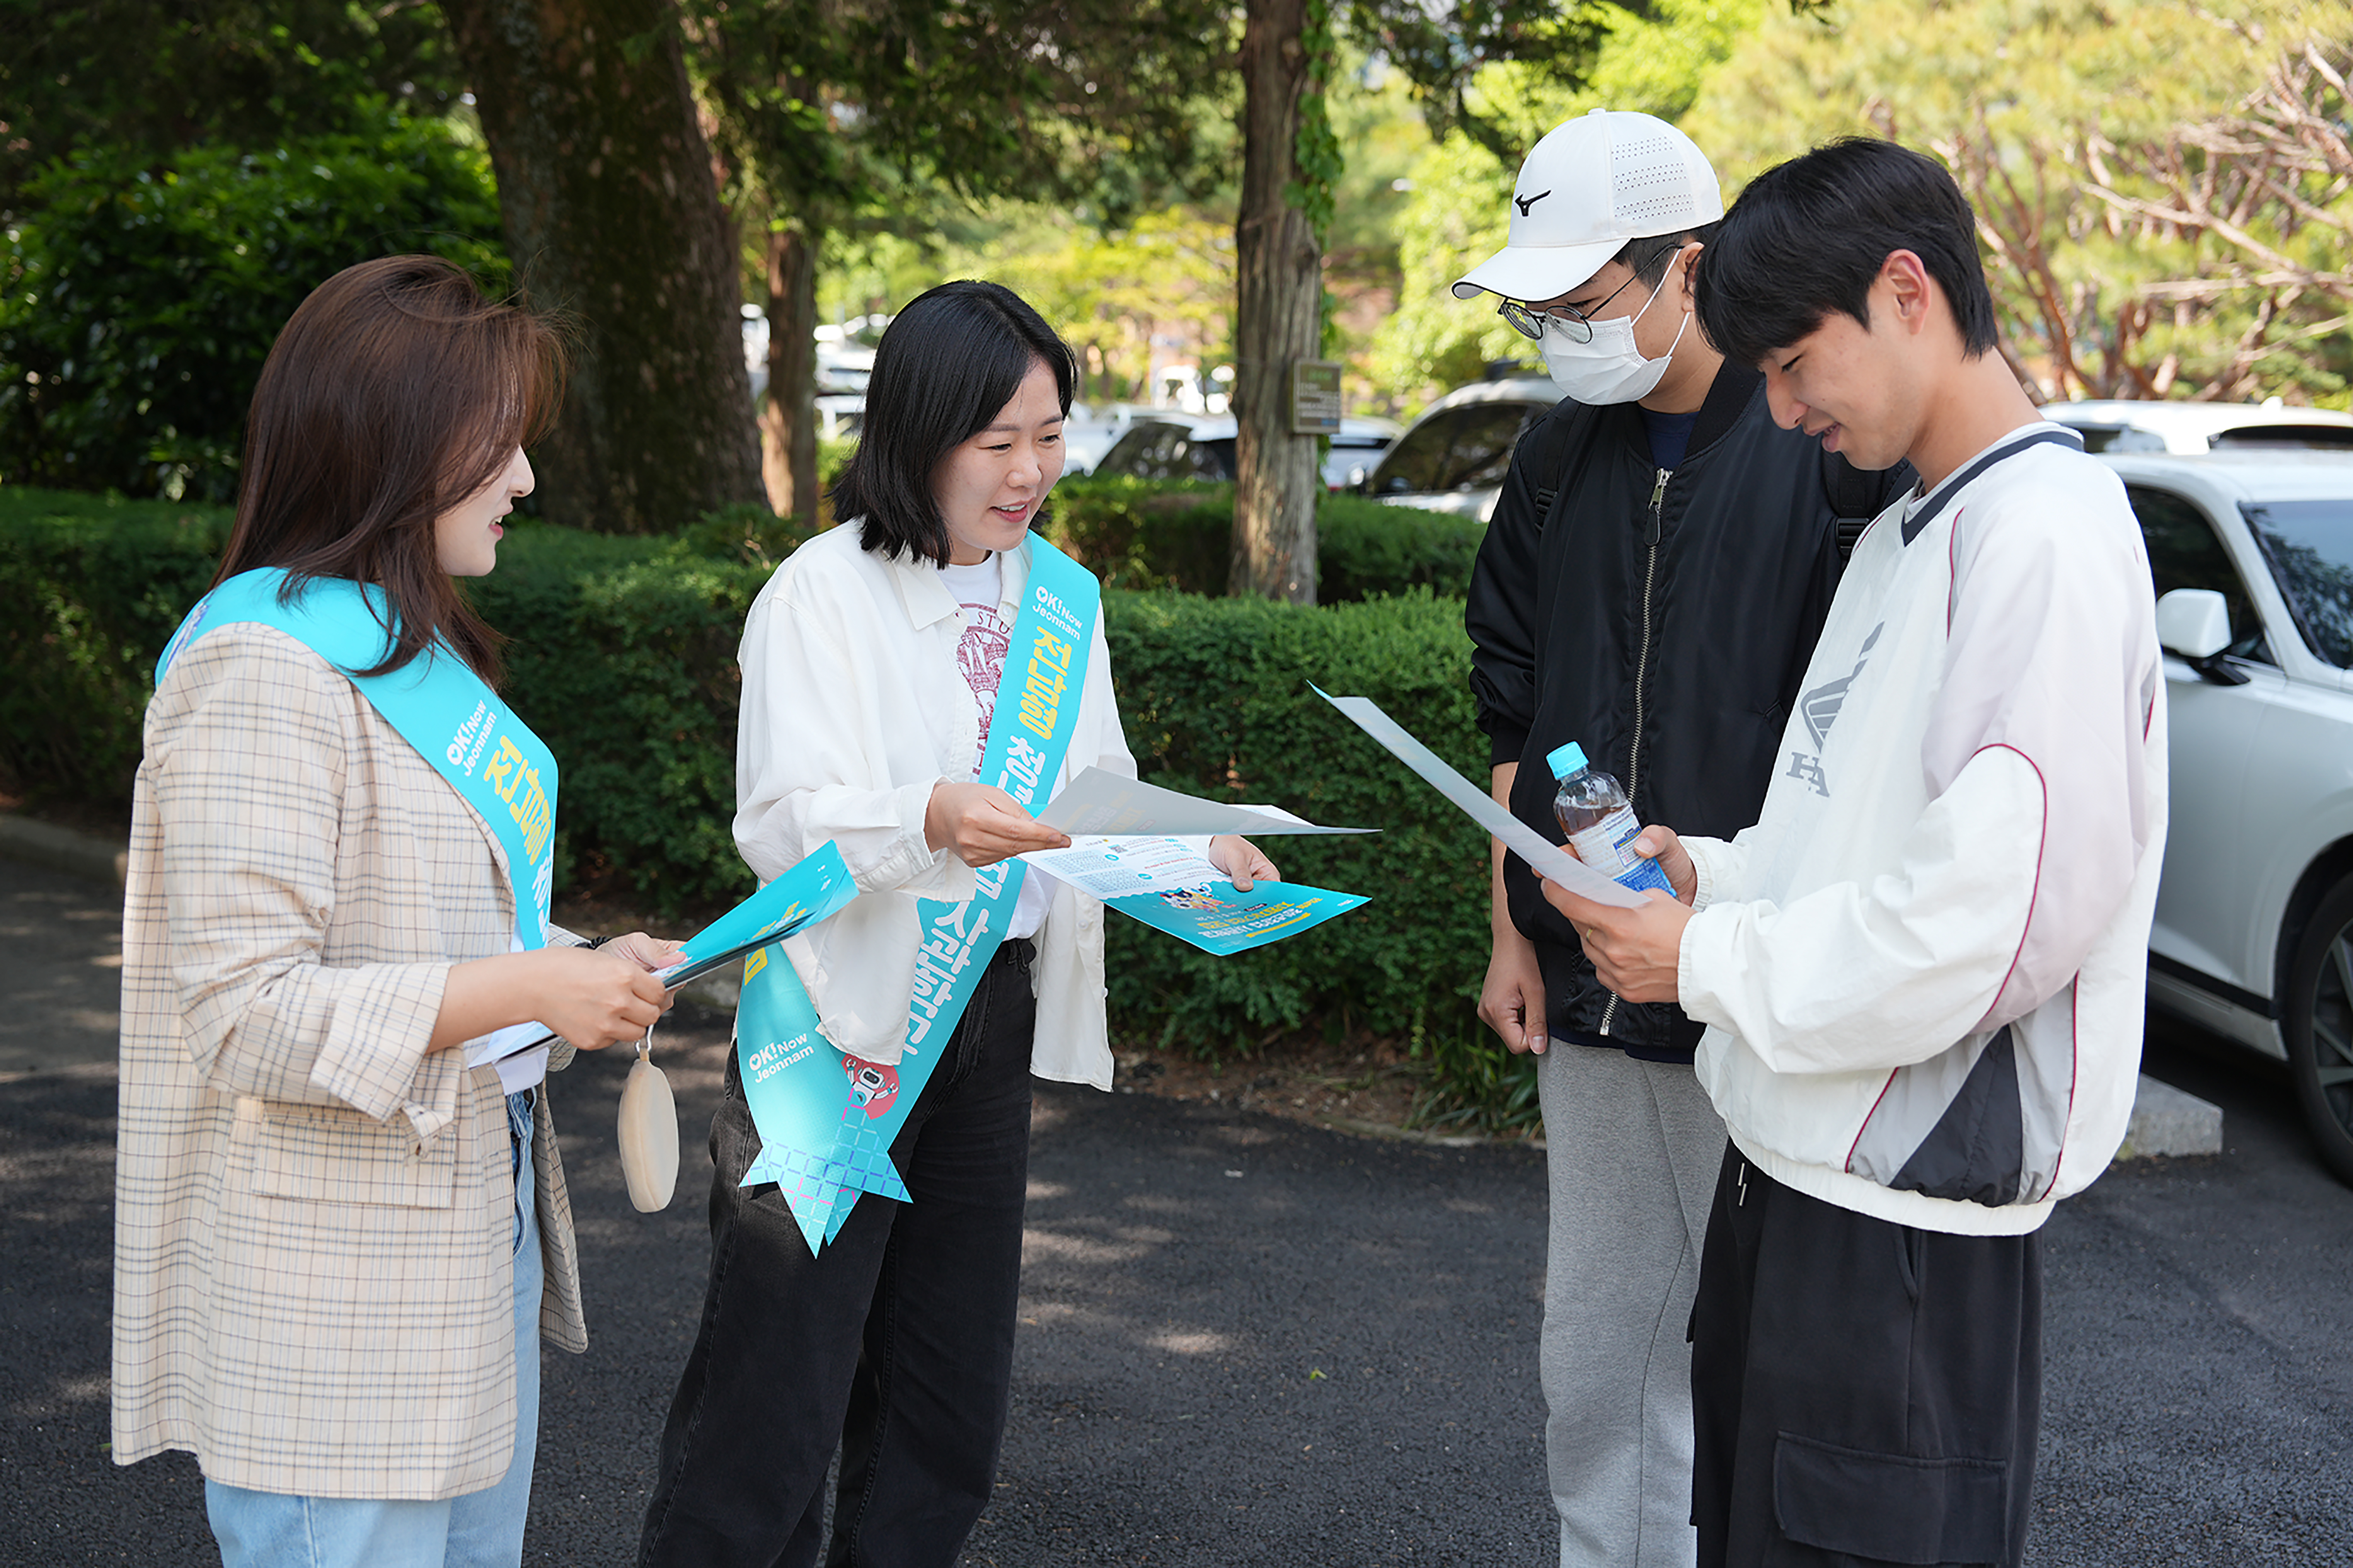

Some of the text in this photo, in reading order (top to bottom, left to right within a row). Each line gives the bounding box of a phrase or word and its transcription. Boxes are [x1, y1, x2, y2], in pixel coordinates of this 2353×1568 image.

[1035, 586, 1063, 614] OK!
[1032, 603, 1081, 640] Jeonnam
[1018, 626, 1072, 740] 전남형
[446, 722, 474, 765] OK!
[462, 711, 497, 777] Jeonnam
[483, 734, 552, 866] 전남형
[749, 1033, 808, 1071] OK! Now
[755, 1046, 815, 1083] Jeonnam
